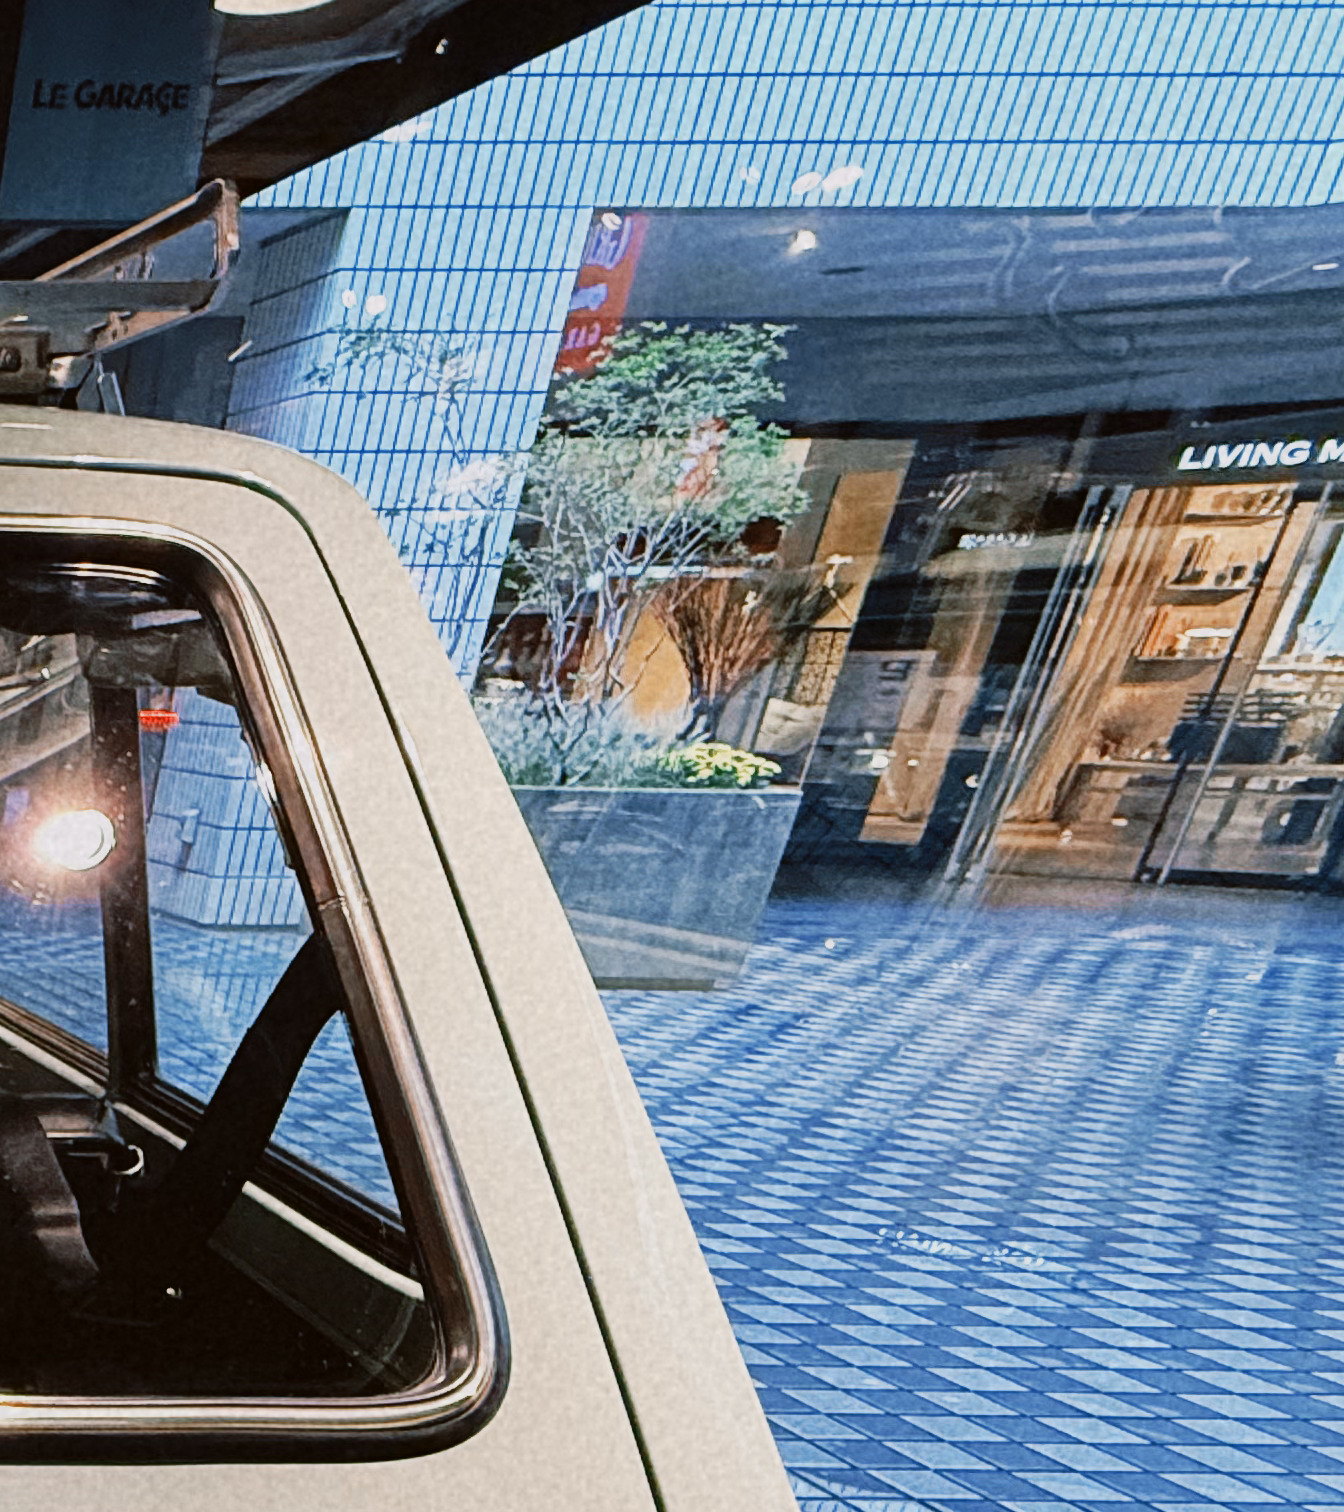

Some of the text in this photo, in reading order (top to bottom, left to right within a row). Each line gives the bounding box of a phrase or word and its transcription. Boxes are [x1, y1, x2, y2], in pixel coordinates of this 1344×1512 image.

[32, 78, 191, 116] LE GARAGE
[1176, 439, 1313, 471] LIVING
